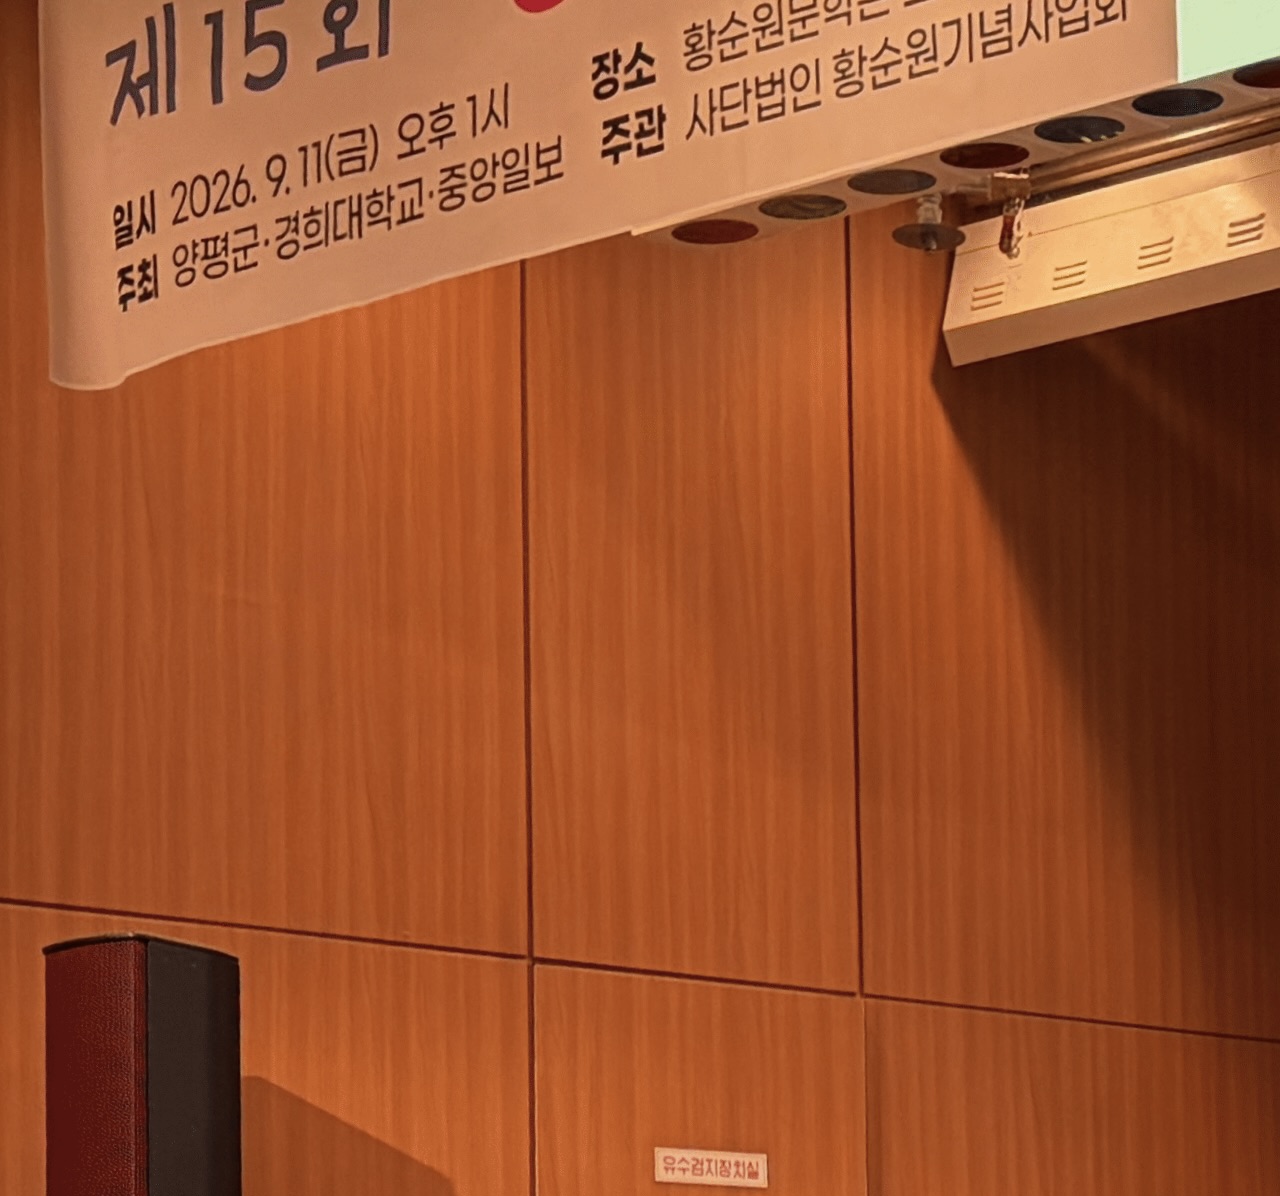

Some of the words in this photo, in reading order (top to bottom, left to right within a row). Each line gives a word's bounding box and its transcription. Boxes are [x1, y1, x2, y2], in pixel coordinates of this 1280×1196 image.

[591, 41, 657, 101] 장소
[600, 103, 667, 165] 주관
[684, 57, 822, 141] 사단법인
[112, 189, 156, 251] 일시
[397, 101, 457, 160] 오후
[466, 82, 509, 138] 1시
[116, 253, 159, 313] 주최
[662, 1155, 760, 1180] 유수검지장치실
